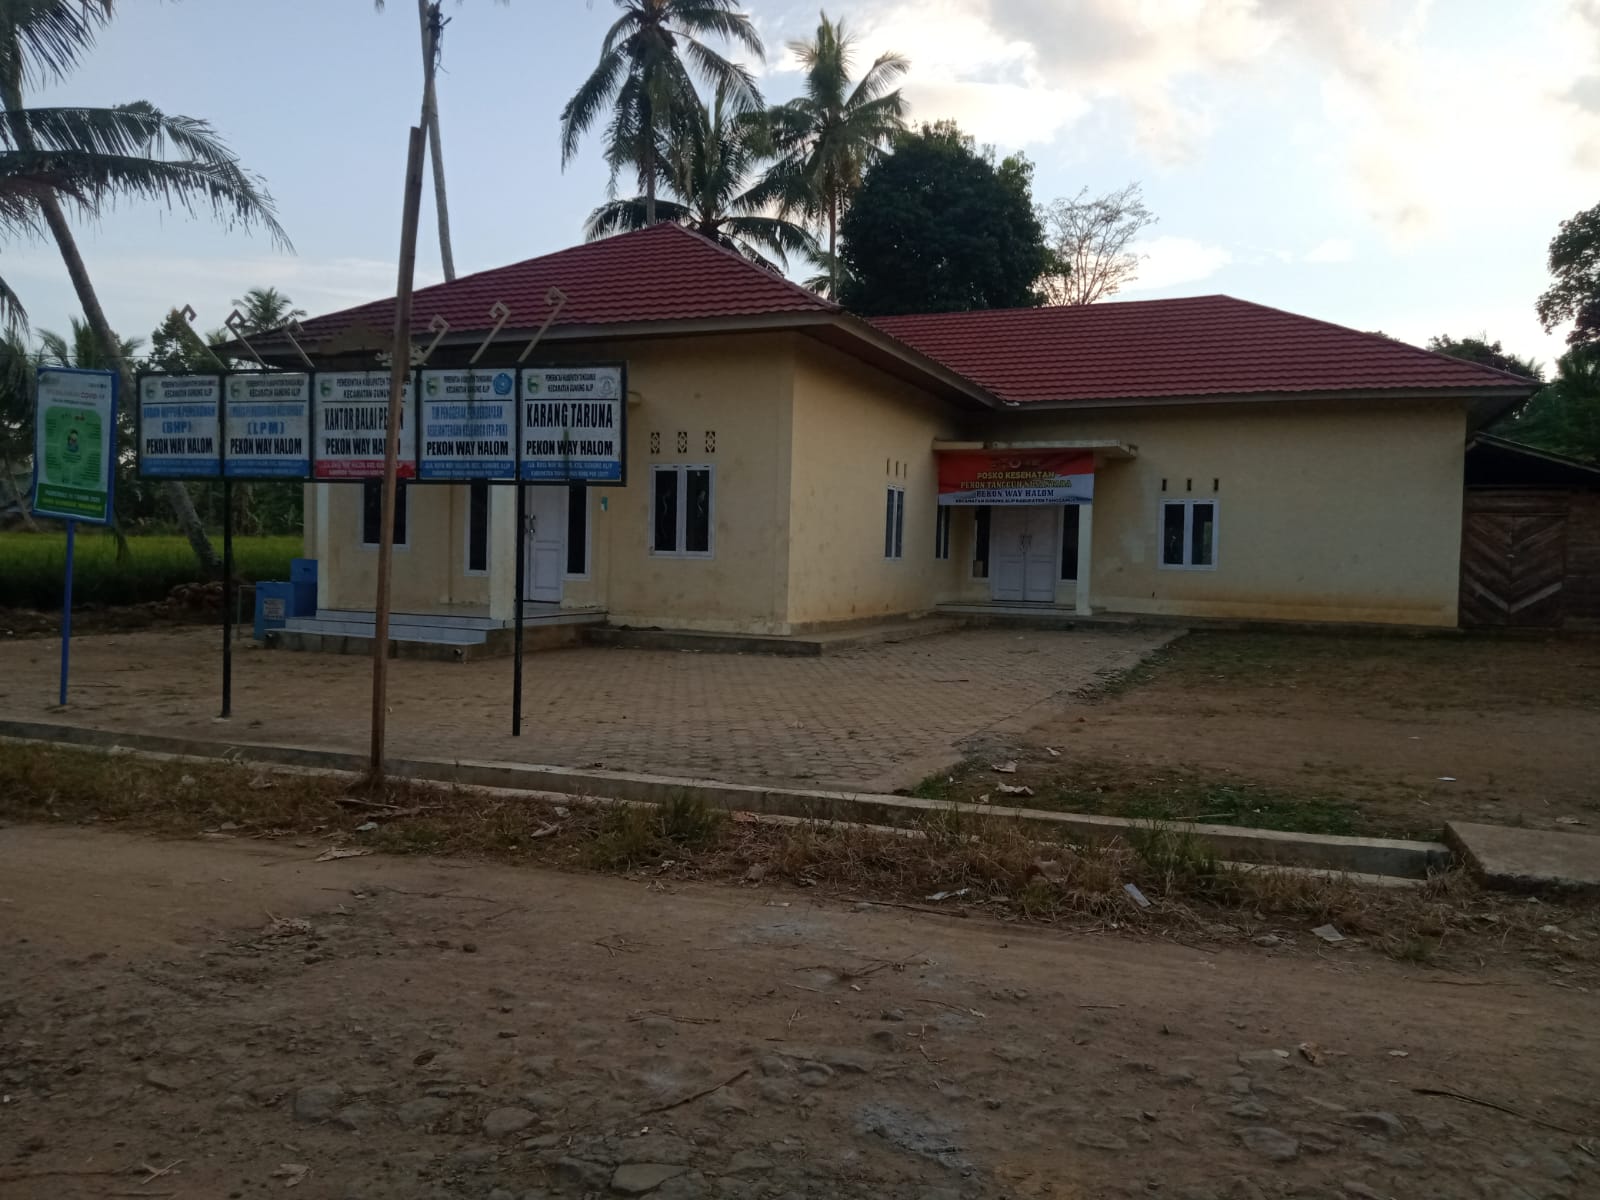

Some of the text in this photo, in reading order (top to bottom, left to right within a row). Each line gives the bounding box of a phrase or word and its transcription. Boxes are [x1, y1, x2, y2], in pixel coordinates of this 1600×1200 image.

[324, 408, 354, 431] KANTOR
[355, 408, 377, 431] BALAI
[378, 407, 404, 431] PEN
[526, 403, 613, 429] KARANG TARUNA
[146, 437, 213, 454] PEKON WAY HALOM
[230, 438, 302, 455] PEKON WAY HALOM
[326, 438, 352, 456] PEKON
[353, 438, 371, 456] WAY
[426, 441, 509, 456] PEKON WAY HALOM
[526, 440, 613, 456] PEKON WAY HALOM
[976, 471, 1056, 480] POSKO KESEHATAN
[1004, 489, 1023, 498] WAY
[1024, 489, 1055, 498] HALOM
